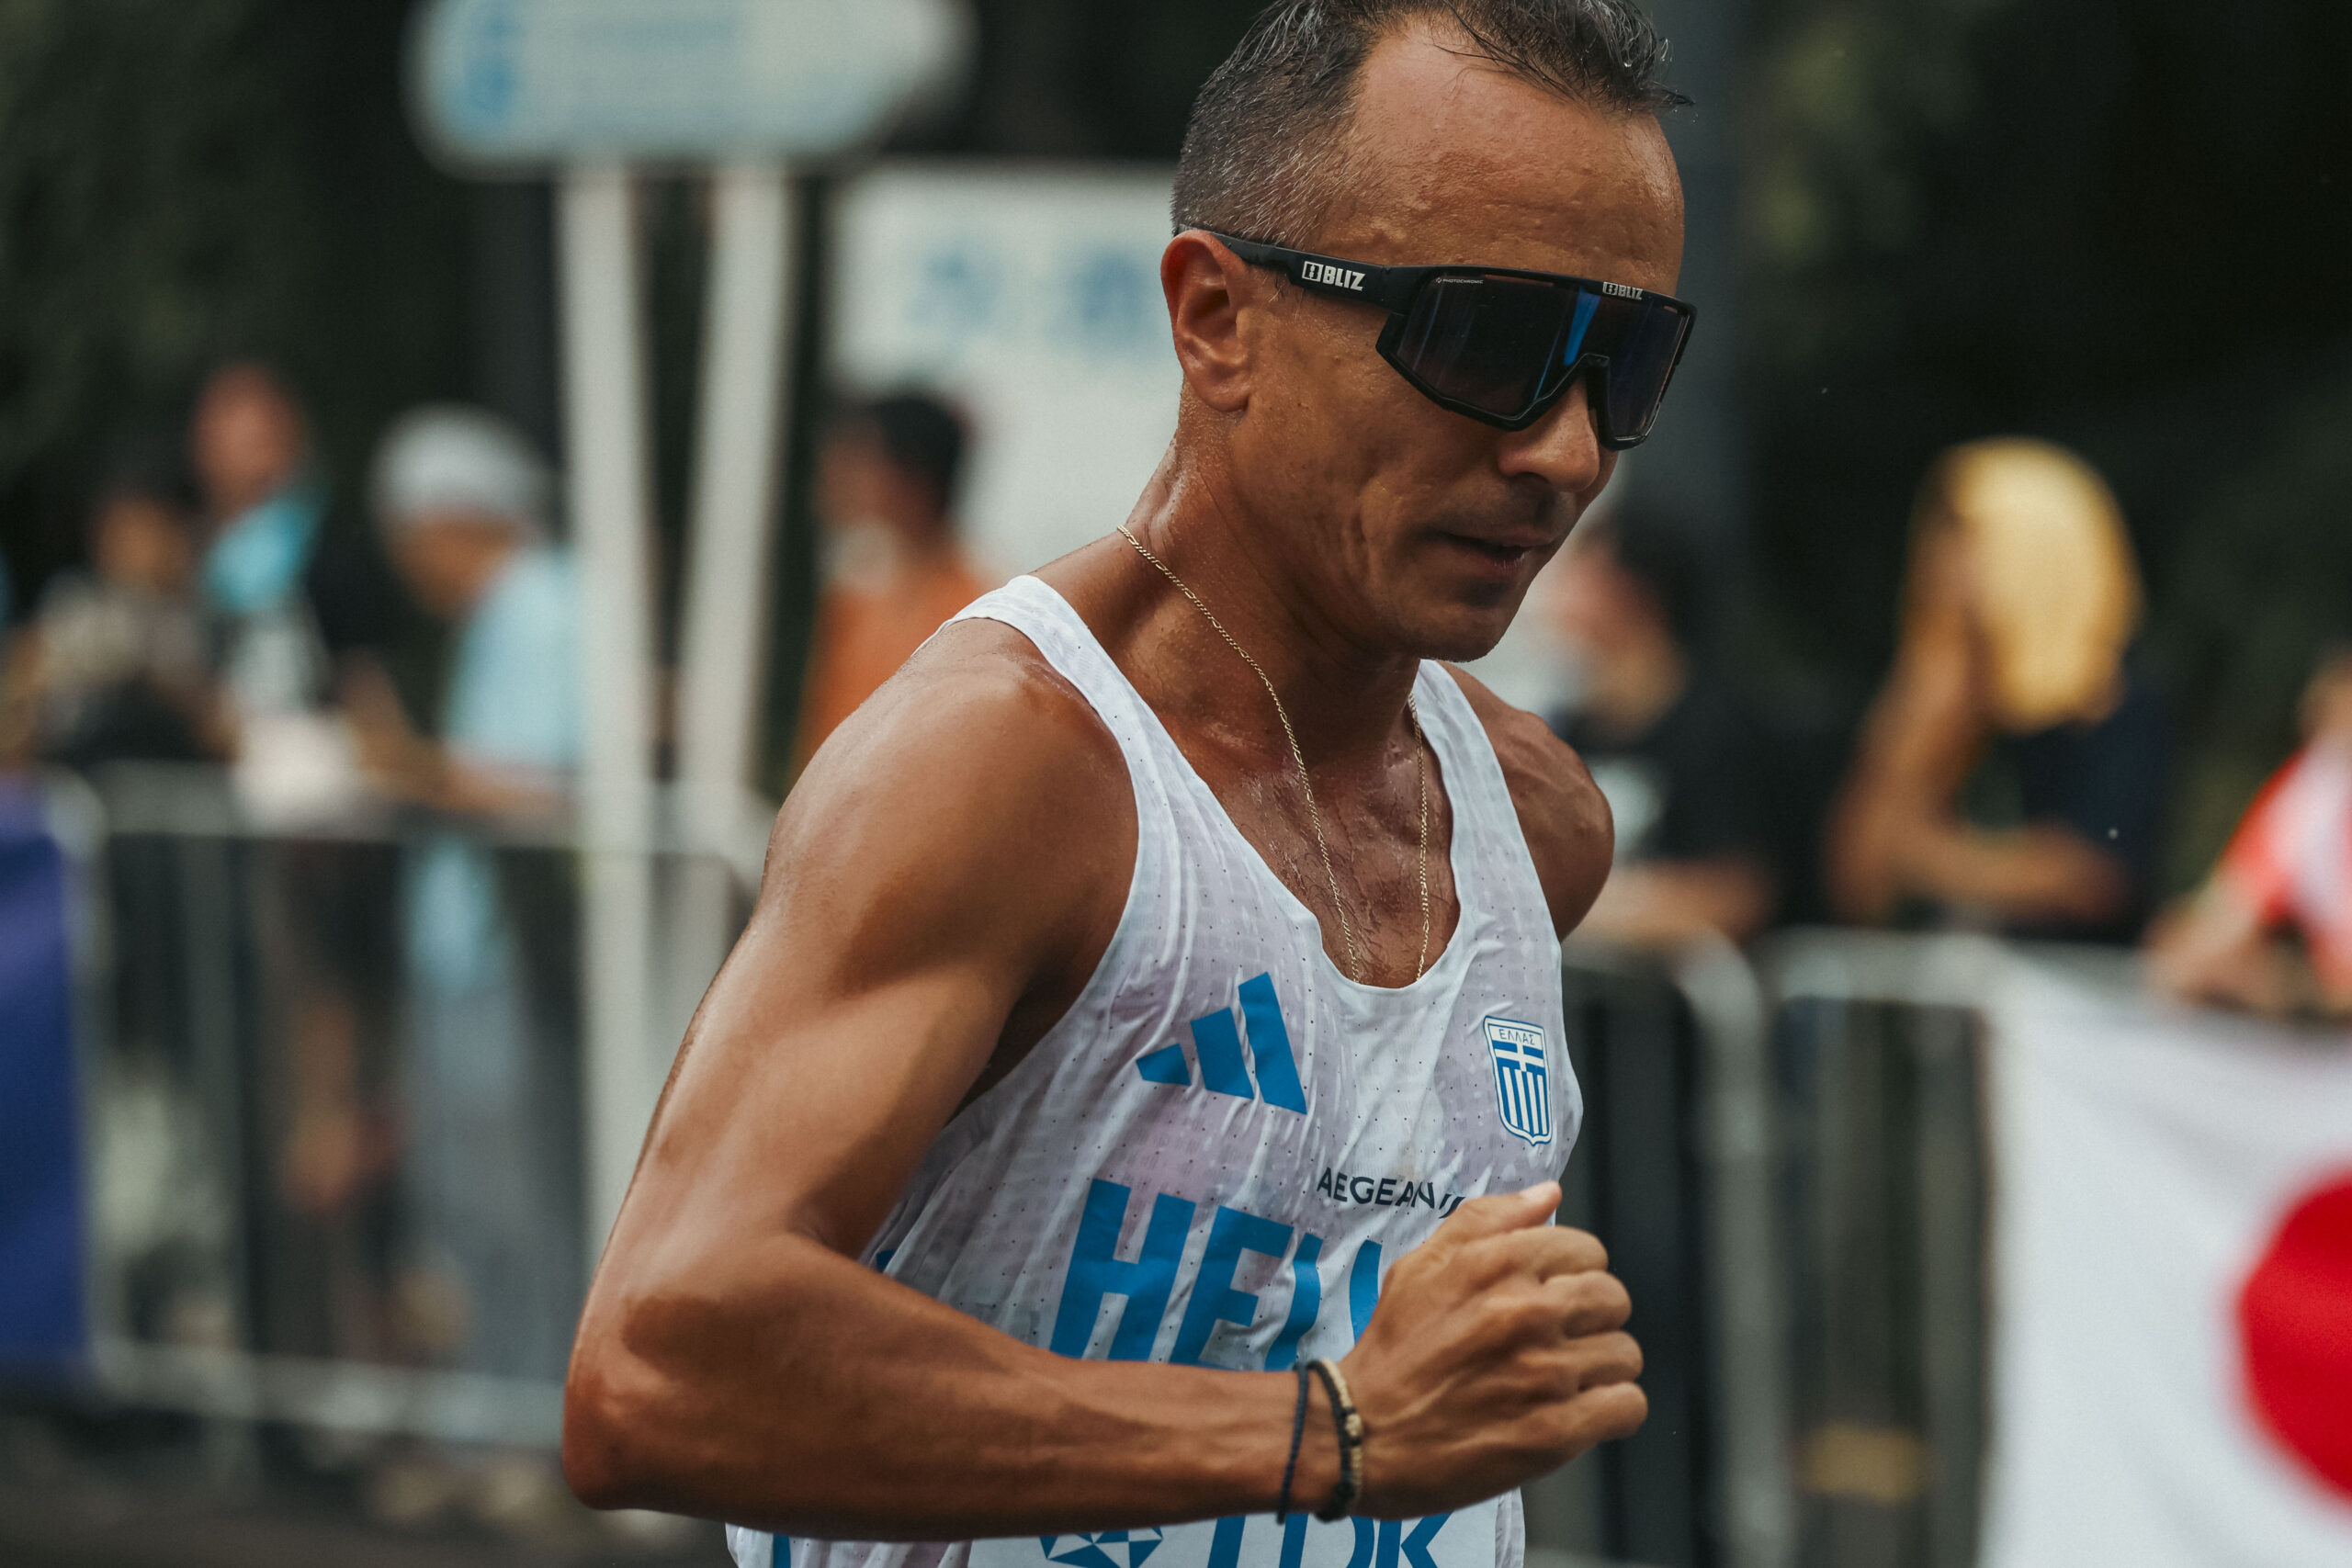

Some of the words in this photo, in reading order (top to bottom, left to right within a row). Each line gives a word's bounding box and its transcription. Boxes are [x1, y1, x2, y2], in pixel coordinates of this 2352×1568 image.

[1322, 265, 1366, 291] BLIZ
[1618, 284, 1644, 300] BLIZ
[1317, 1167, 1435, 1209] AEGEAN
